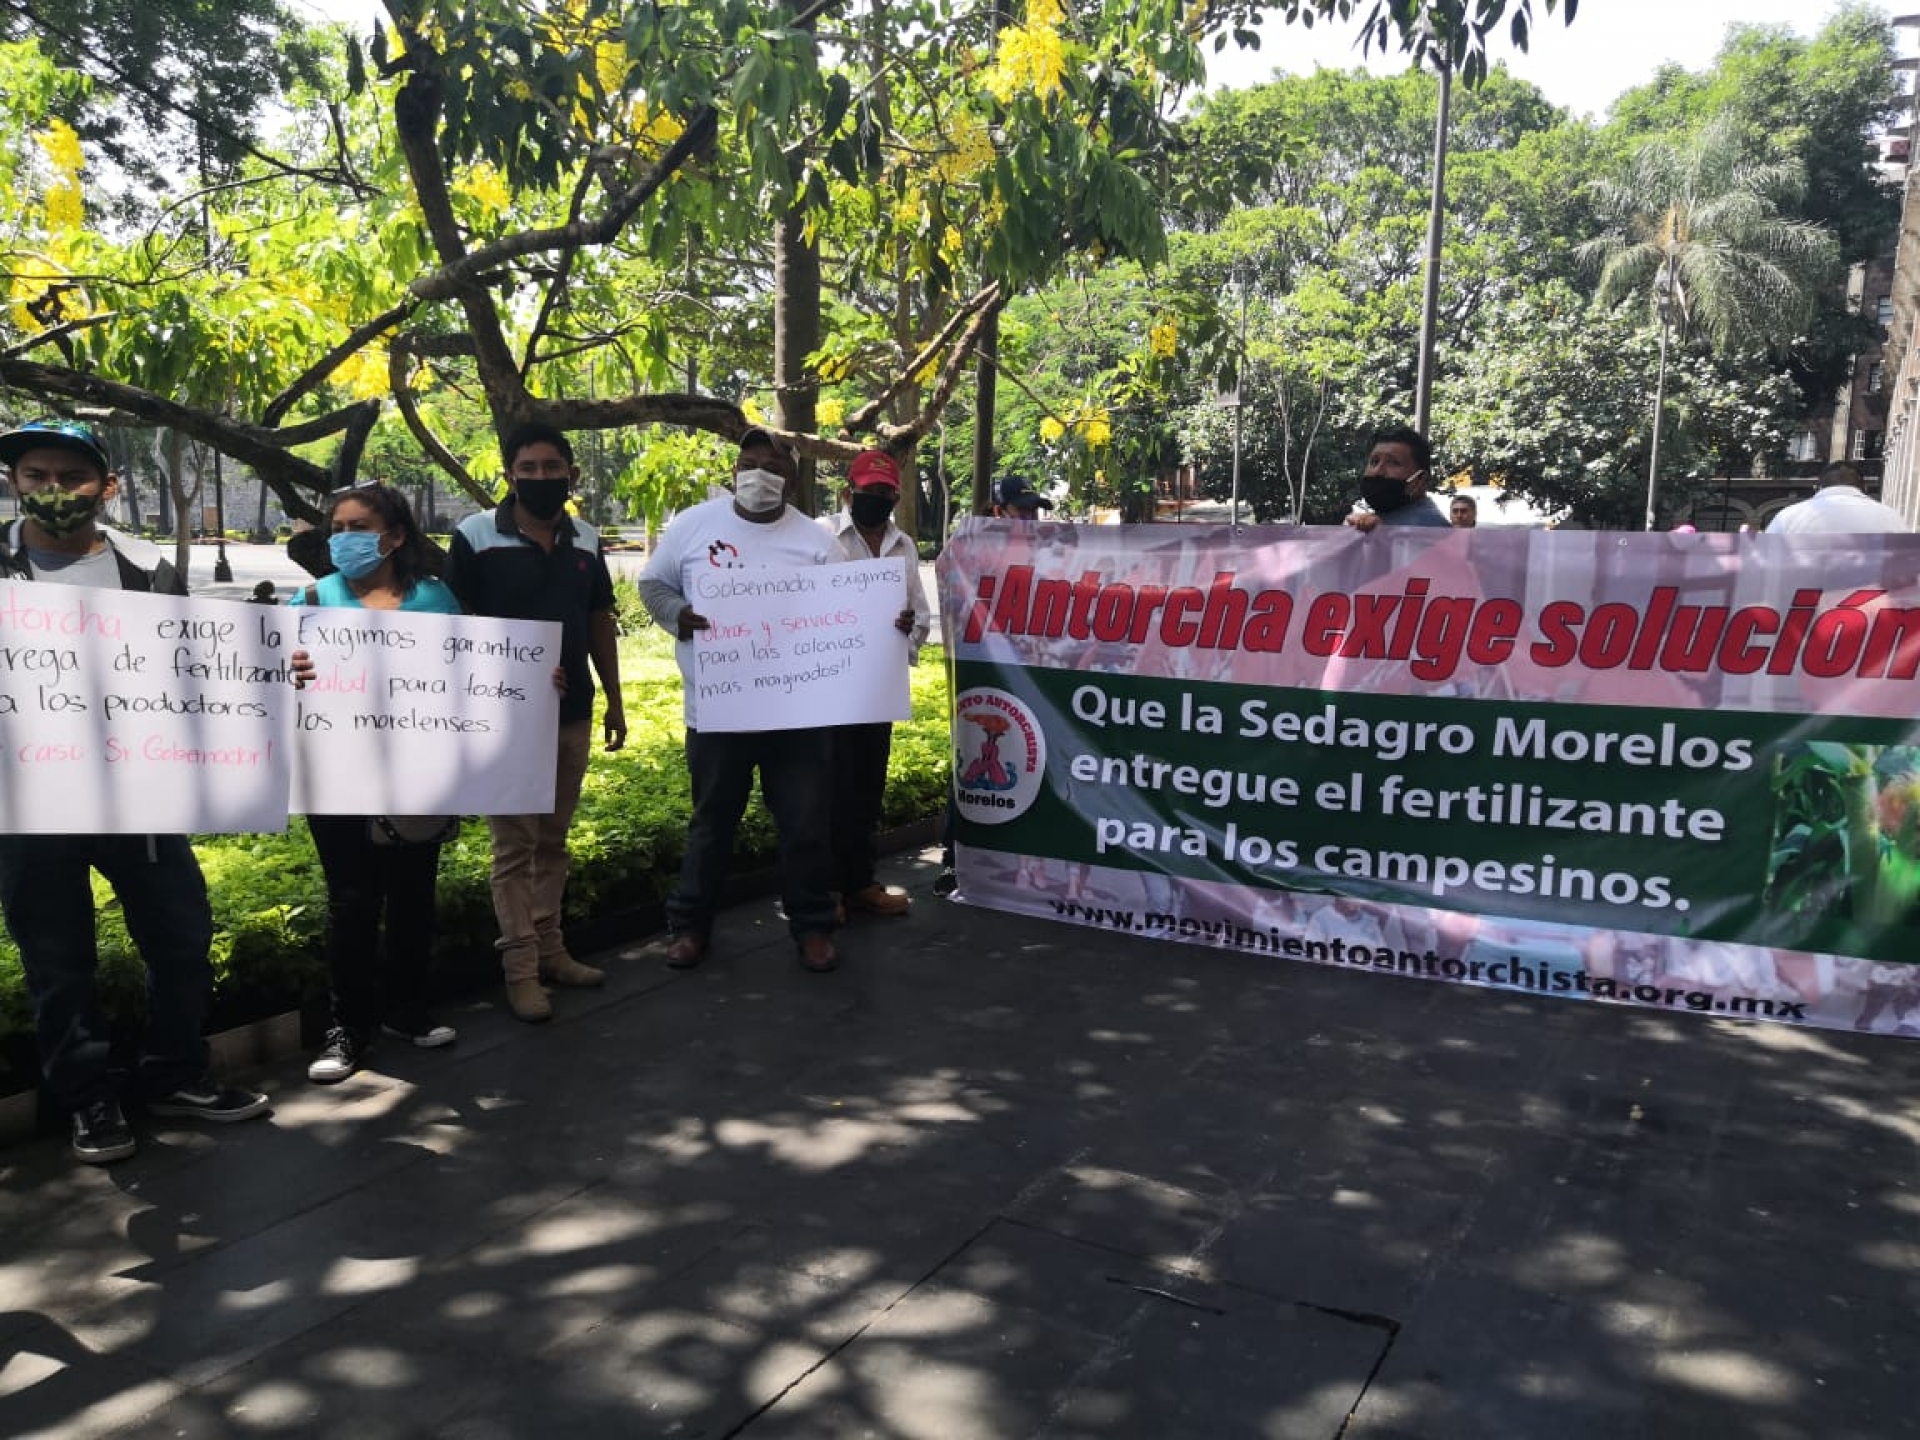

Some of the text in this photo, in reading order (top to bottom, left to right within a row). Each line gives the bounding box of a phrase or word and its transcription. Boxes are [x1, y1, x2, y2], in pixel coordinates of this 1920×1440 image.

[831, 570, 901, 592] exigimos
[0, 586, 281, 658] torcha exige la
[298, 612, 545, 663] Exigimos garantice
[761, 620, 773, 641] y
[963, 565, 1294, 654] ¡Antorcha
[1302, 577, 1523, 681] exige
[0, 648, 80, 688] rega
[114, 643, 146, 671] de
[698, 634, 866, 673] para las colonias
[39, 684, 87, 712] los
[104, 692, 268, 720] productores
[389, 675, 446, 698] para
[467, 672, 526, 701] todos
[700, 679, 742, 699] mas
[297, 701, 491, 733] los morelenses
[1071, 684, 1754, 772] Que la Sedagro Morelos
[1070, 753, 1726, 842] entregue el fertilizante
[1096, 816, 1691, 911] para los campesinos.
[1049, 900, 1807, 1019] www.movimientoantorchista.org.mx
